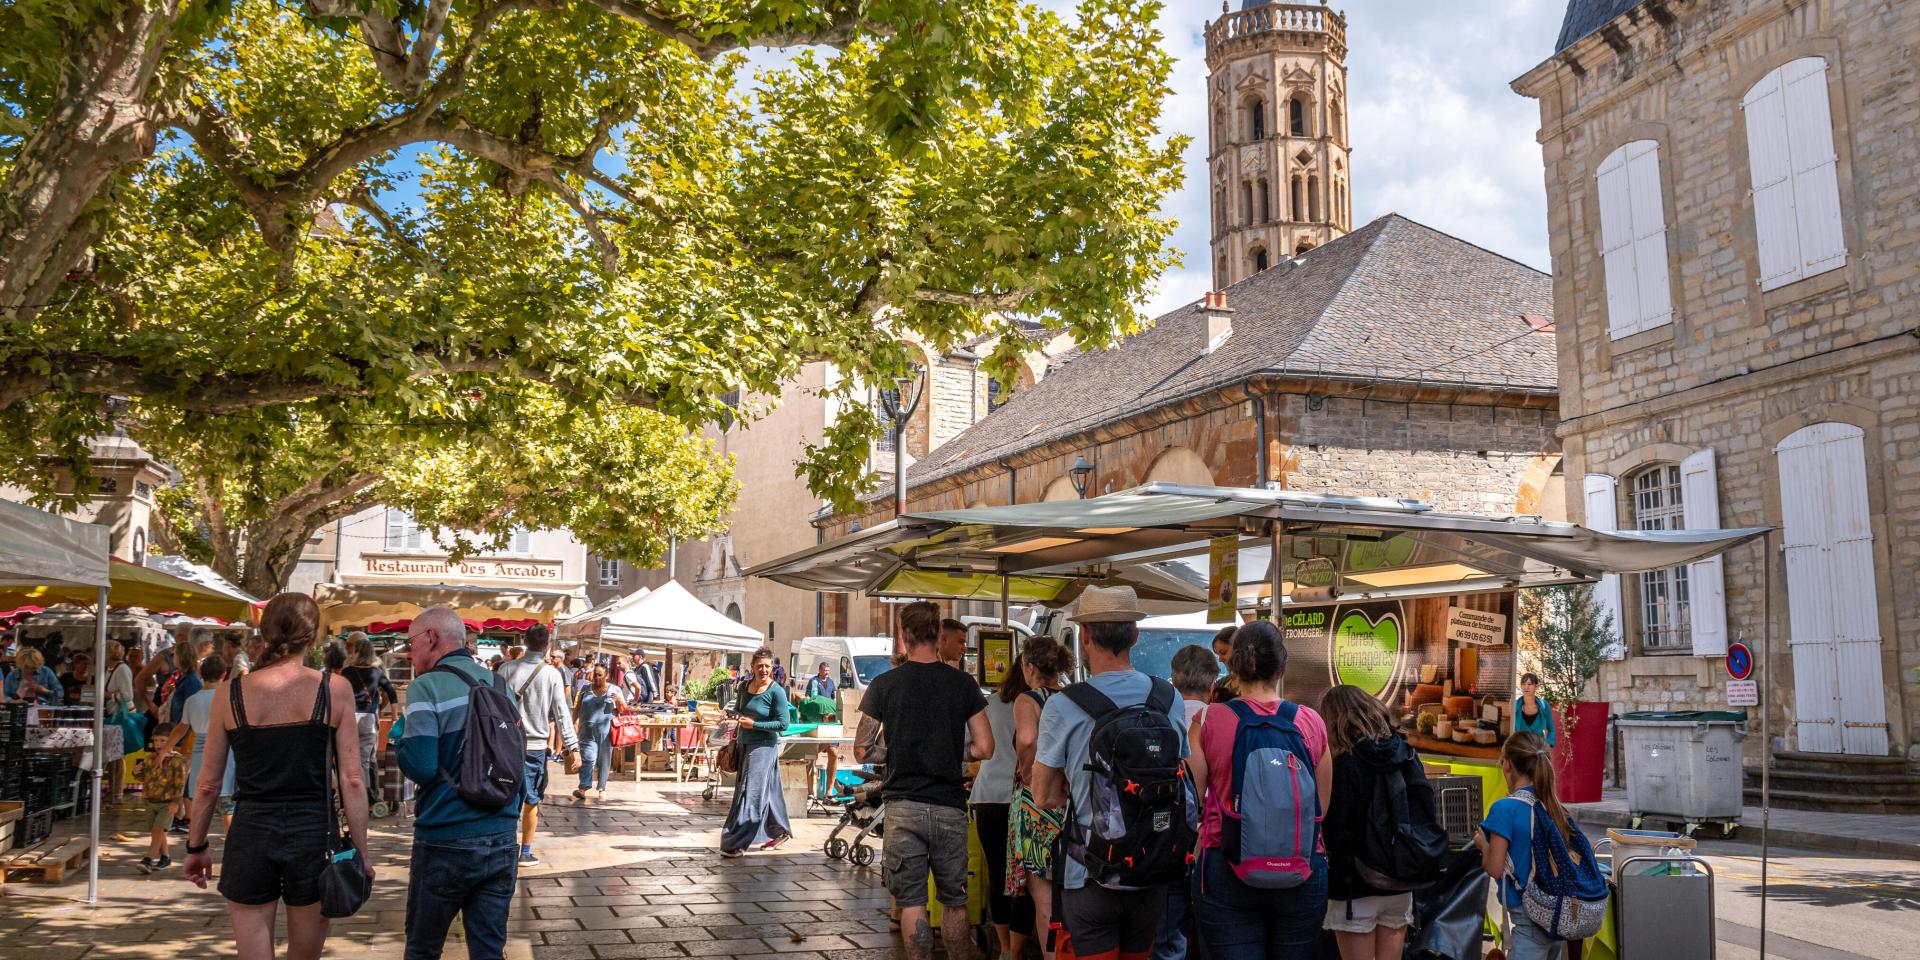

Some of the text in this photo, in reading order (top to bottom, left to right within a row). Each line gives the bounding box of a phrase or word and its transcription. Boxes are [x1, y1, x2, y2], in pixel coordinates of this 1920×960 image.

[366, 559, 556, 578] Restaurant des Arcades
[1292, 611, 1325, 626] CÉLARD
[1459, 611, 1487, 622] Commande
[1451, 618, 1471, 627] plateaux
[1478, 622, 1501, 633] fromages
[1346, 625, 1375, 647] Terres
[1456, 629, 1464, 638] 06
